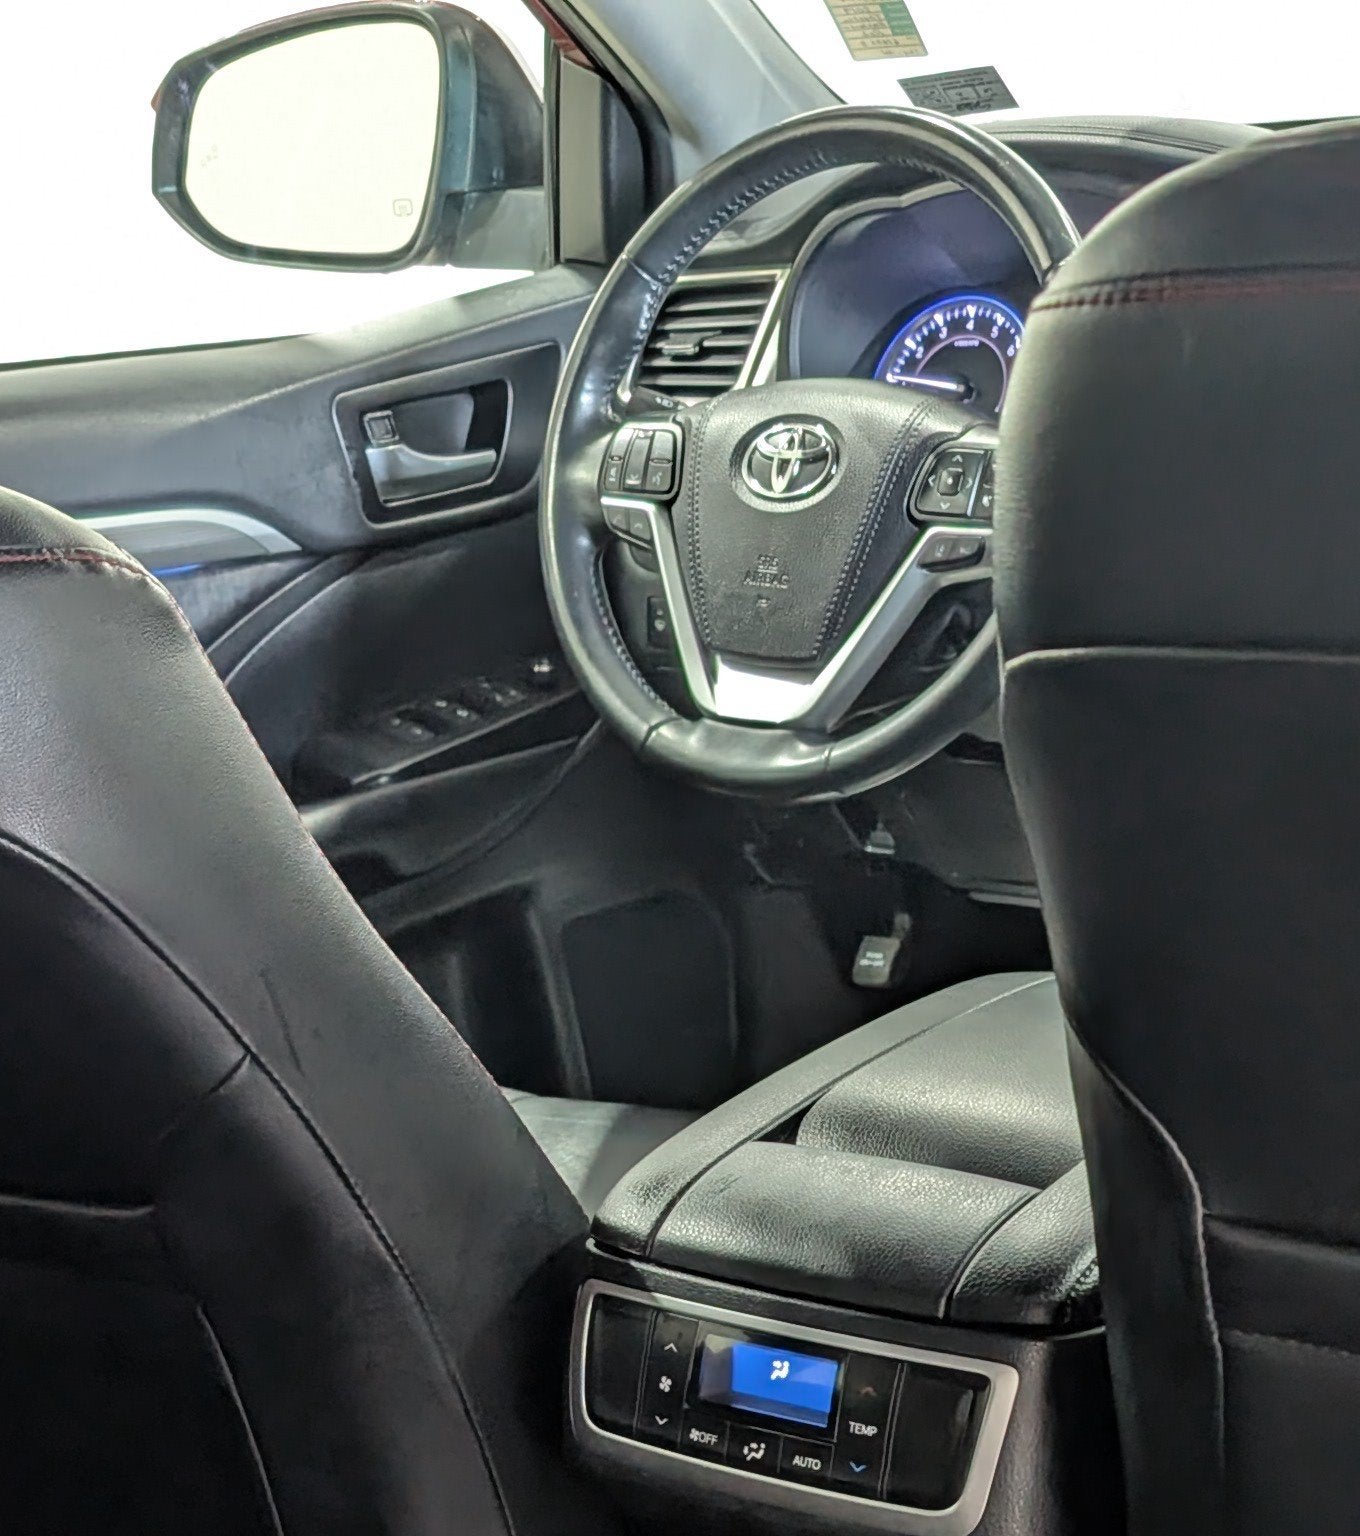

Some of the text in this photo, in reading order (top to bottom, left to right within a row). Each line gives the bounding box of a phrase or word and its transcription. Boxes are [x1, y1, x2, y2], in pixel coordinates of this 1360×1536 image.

[939, 326, 948, 339] 3
[966, 319, 975, 331] 4
[742, 573, 790, 589] AIRBAG
[848, 1421, 878, 1437] TEMP
[698, 1432, 719, 1446] OFF
[792, 1455, 822, 1471] AUTO
